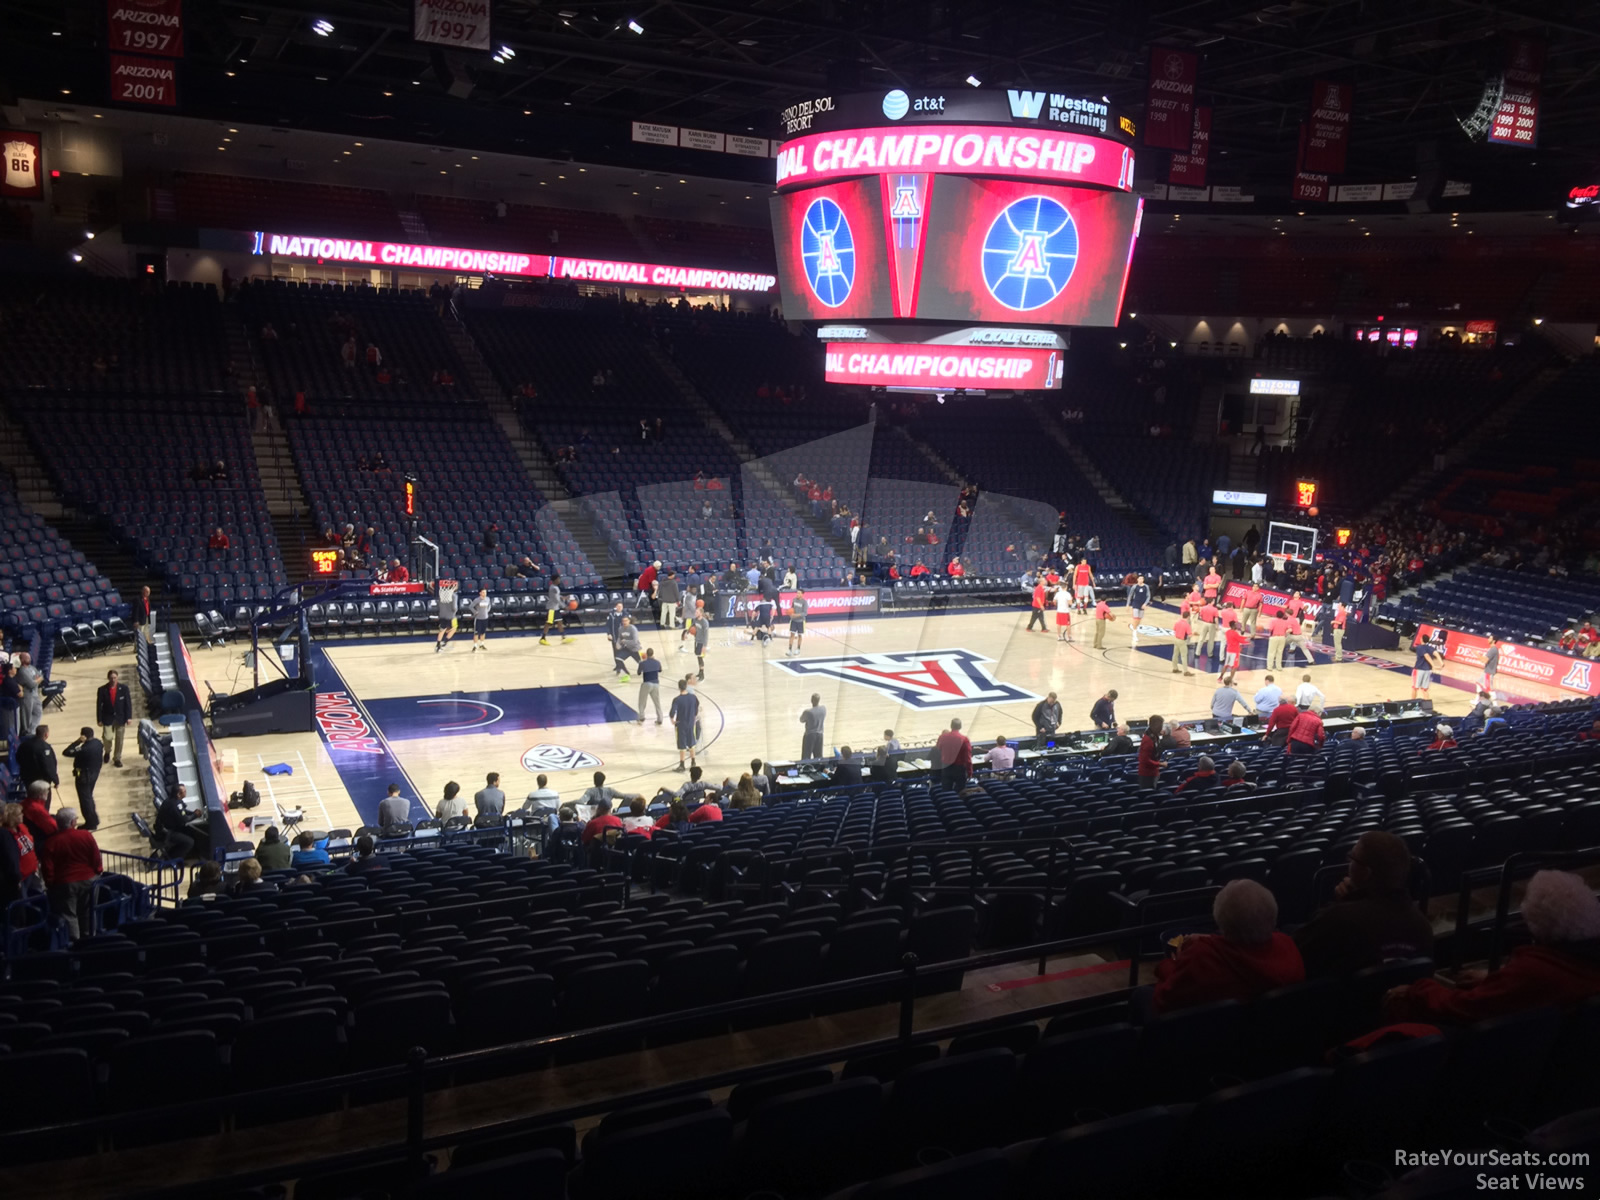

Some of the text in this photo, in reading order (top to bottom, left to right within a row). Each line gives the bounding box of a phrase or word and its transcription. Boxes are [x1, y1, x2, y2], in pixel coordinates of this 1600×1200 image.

[112, 8, 180, 28] ARIZONA
[430, 19, 477, 41] 1997
[122, 30, 171, 50] 1997
[115, 64, 173, 80] ARIZONA
[122, 82, 164, 101] 2001
[1151, 79, 1193, 94] ARIZONA
[798, 100, 815, 117] DEL
[814, 96, 836, 113] SOL
[913, 96, 946, 111] at&t
[1049, 93, 1108, 116] Western
[1150, 98, 1190, 112] SWEET 16
[1504, 92, 1532, 104] SIXTEEN
[1150, 111, 1168, 122] 1998
[1312, 108, 1350, 122] ARIZONA
[1519, 105, 1536, 116] 1994
[787, 115, 813, 134] RESORT
[1049, 107, 1107, 132] Refining
[1497, 114, 1534, 129] 1999 2000
[1493, 126, 1533, 141] 2001 2002
[813, 134, 1096, 173] CHAMPIONSHIP
[12, 158, 30, 172] 86
[1172, 162, 1188, 173] 2005
[1299, 184, 1323, 198] 1993
[253, 231, 530, 273] 1 NATIONAL CHAMPIONSHIP
[549, 256, 777, 292] 1 NATIONAL CHAMPIONSHIP
[848, 353, 1033, 379] CHAMPIONSHIP
[1300, 492, 1313, 506] 30
[318, 560, 332, 573] 30
[726, 596, 736, 618] 1
[1499, 655, 1554, 677] DIAMOND
[315, 691, 385, 755] ARIZONA
